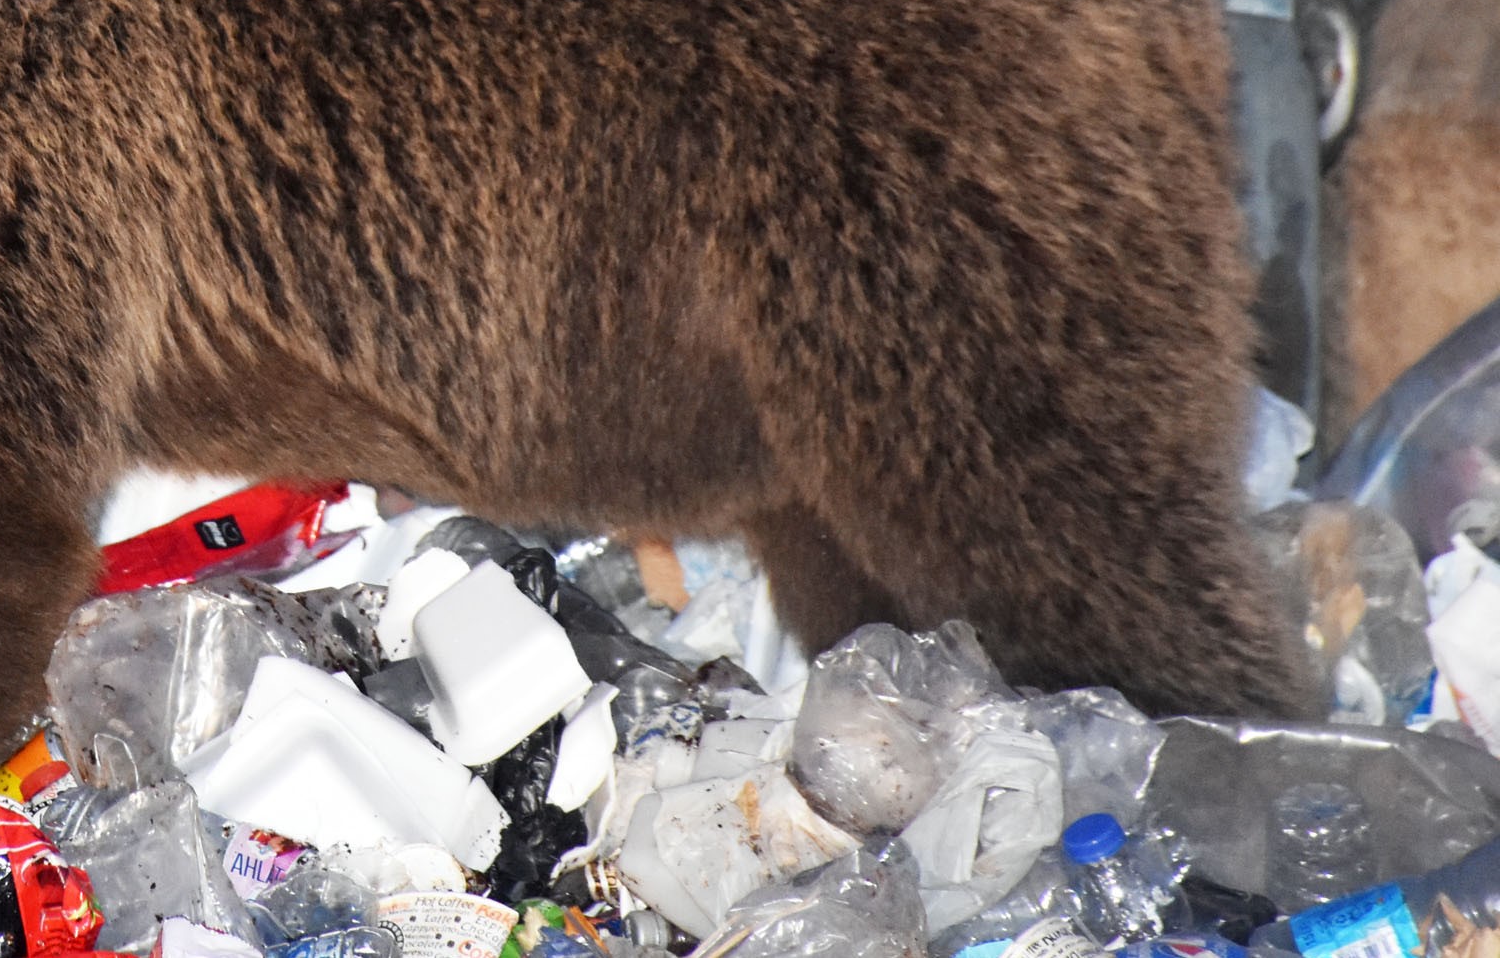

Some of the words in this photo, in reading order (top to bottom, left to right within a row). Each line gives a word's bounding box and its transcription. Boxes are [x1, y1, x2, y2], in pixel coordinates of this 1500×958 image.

[230, 853, 285, 884] AHLAT
[438, 897, 475, 909] Coffee
[425, 914, 452, 924] Latte
[404, 940, 445, 949] ocolate
